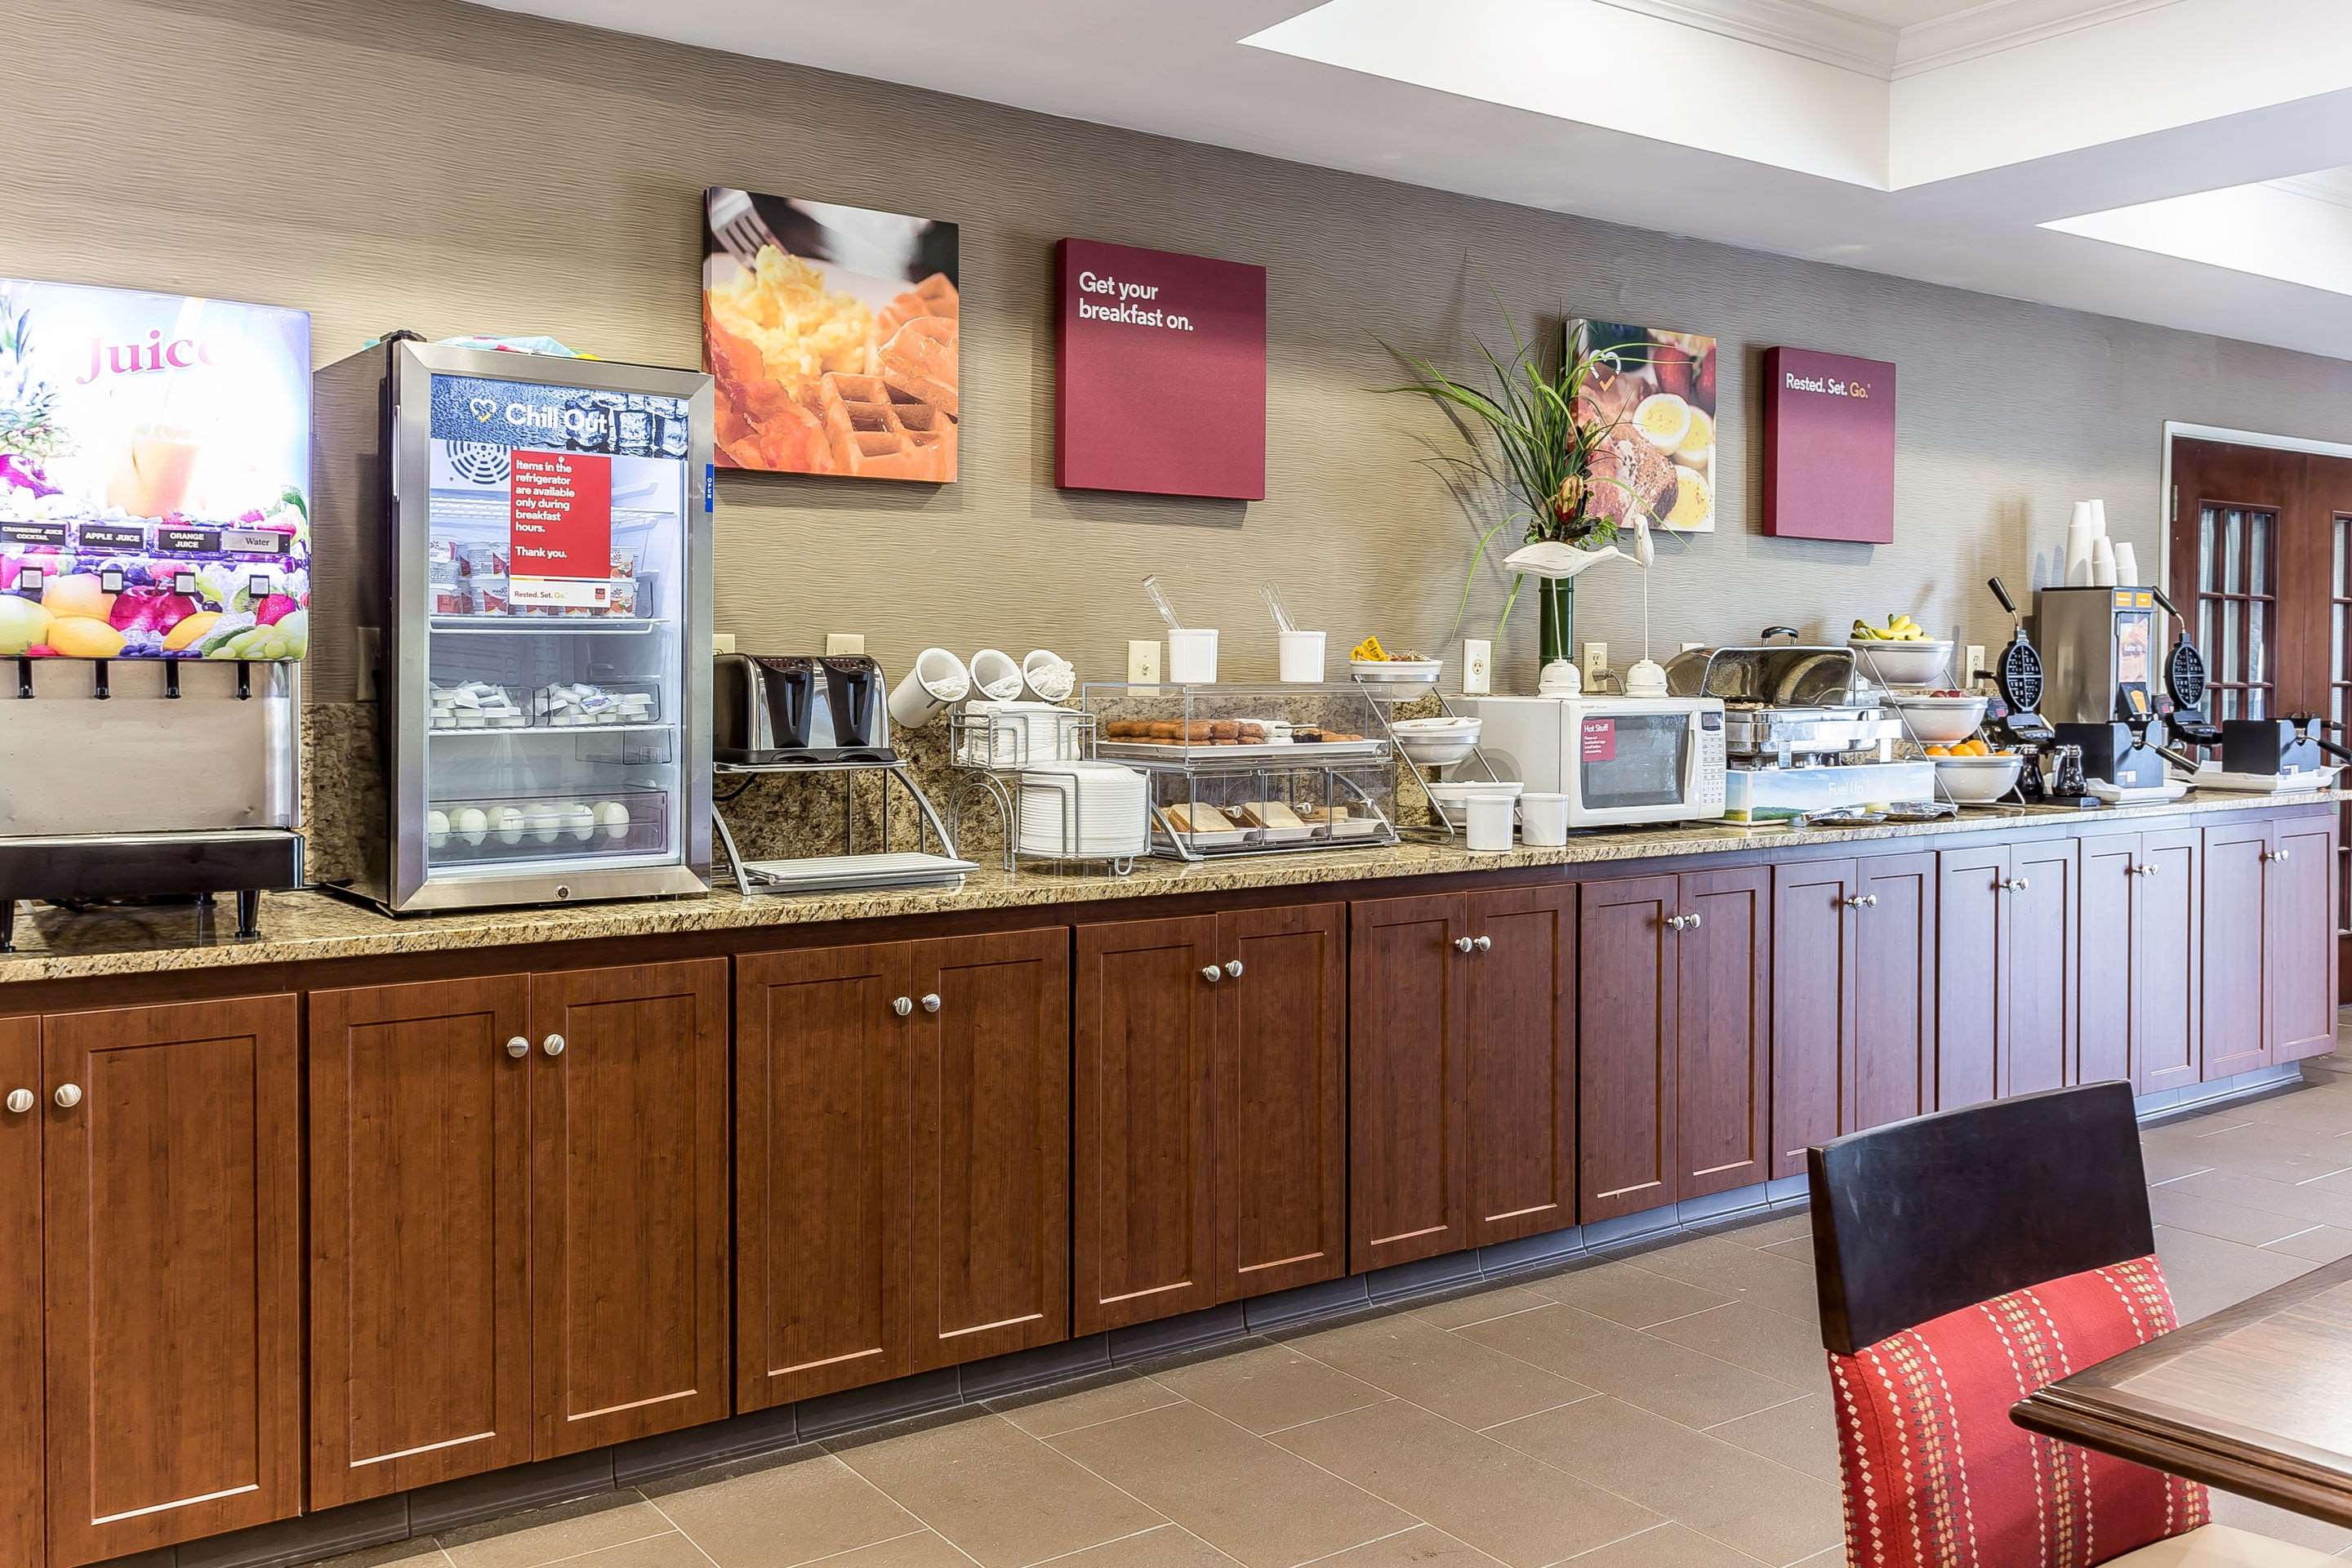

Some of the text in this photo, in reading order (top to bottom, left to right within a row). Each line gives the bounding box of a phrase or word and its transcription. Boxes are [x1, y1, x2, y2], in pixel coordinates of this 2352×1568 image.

[1079, 271, 1158, 301] Get your
[1079, 297, 1194, 332] breakfast on.
[1785, 372, 1826, 394] Rested.
[1828, 378, 1848, 397] Set.
[506, 403, 608, 434] Chill Out
[515, 459, 572, 474] Items in the
[515, 472, 572, 485] refrigerator
[515, 486, 576, 497] are available
[515, 497, 570, 512] only during
[515, 509, 562, 522] breakfast
[515, 521, 546, 533] hours.
[85, 532, 140, 543] APPLE JUICE
[169, 532, 204, 541] ORANGE
[245, 537, 270, 546] Water
[175, 541, 199, 549] JUICE
[515, 546, 568, 559] Thank you.
[514, 590, 539, 599] Rested.
[540, 591, 554, 599] Set.
[1584, 724, 1595, 733] Hot
